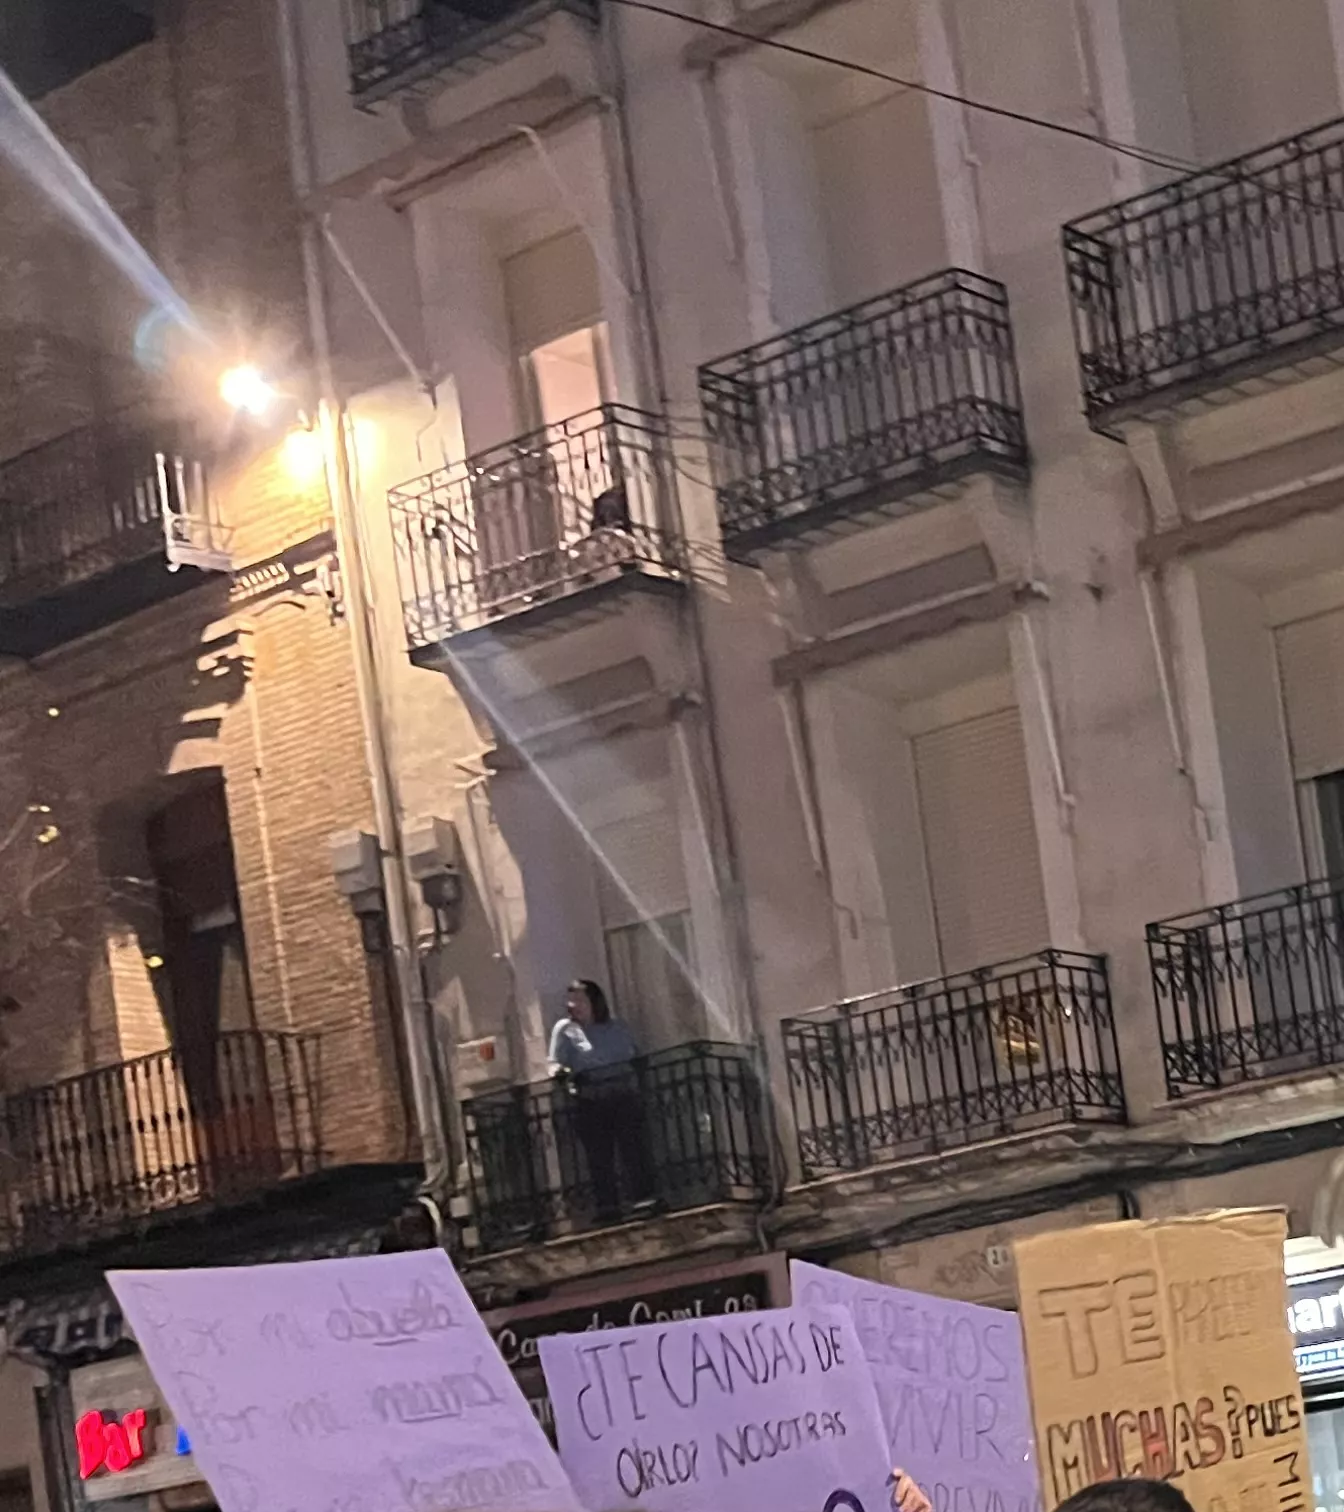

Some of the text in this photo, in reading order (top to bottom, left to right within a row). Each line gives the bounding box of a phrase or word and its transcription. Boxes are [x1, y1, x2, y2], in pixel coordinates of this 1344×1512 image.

[1038, 1268, 1167, 1380] TE
[656, 1320, 807, 1409] CANSAS
[811, 1321, 846, 1374] DE
[75, 1408, 146, 1480] Bar
[715, 1410, 848, 1478] NOSOTRAS
[1245, 1394, 1302, 1440] PUES
